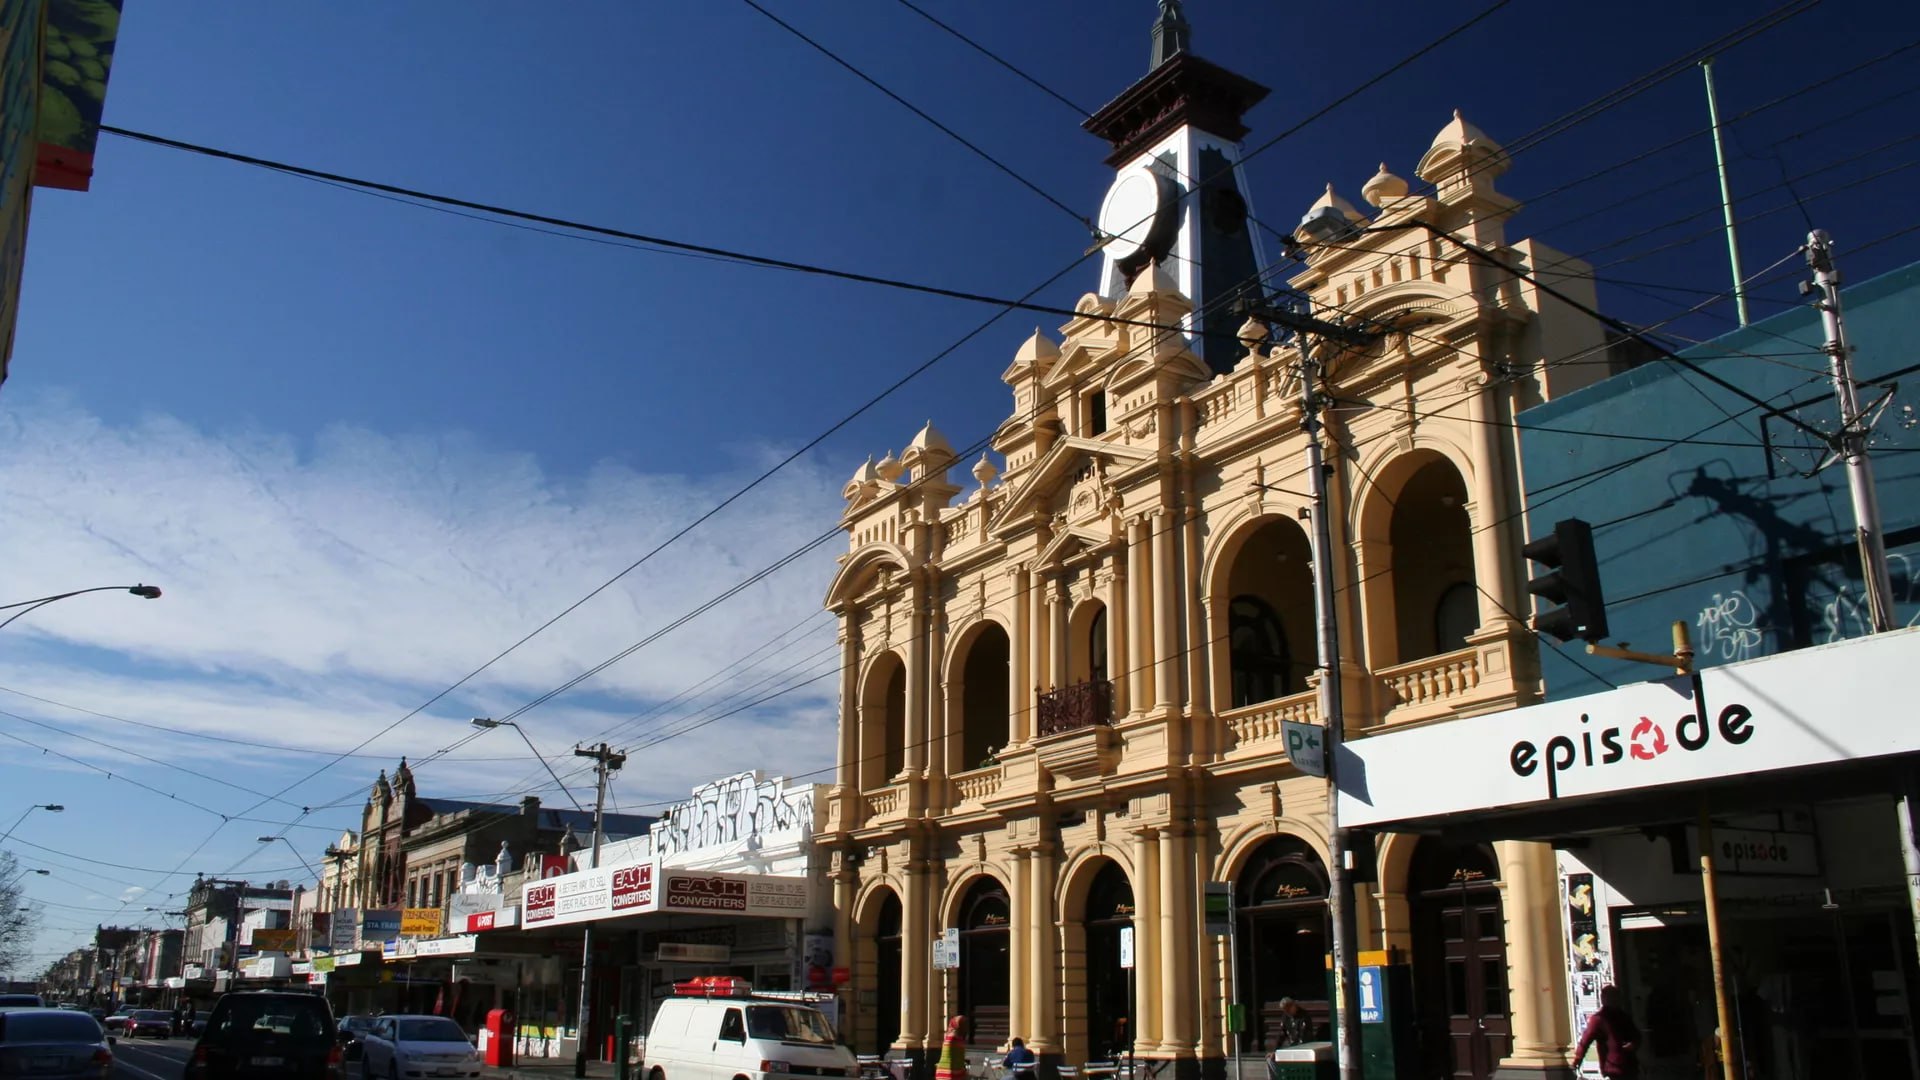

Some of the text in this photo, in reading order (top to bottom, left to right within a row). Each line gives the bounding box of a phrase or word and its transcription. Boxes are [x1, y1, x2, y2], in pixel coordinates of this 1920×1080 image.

[612, 890, 652, 907] CONVERTERS
[669, 895, 745, 909] CONVERTERS
[481, 914, 493, 927] POST
[526, 906, 555, 921] CONVERTERS
[366, 921, 379, 929] STA
